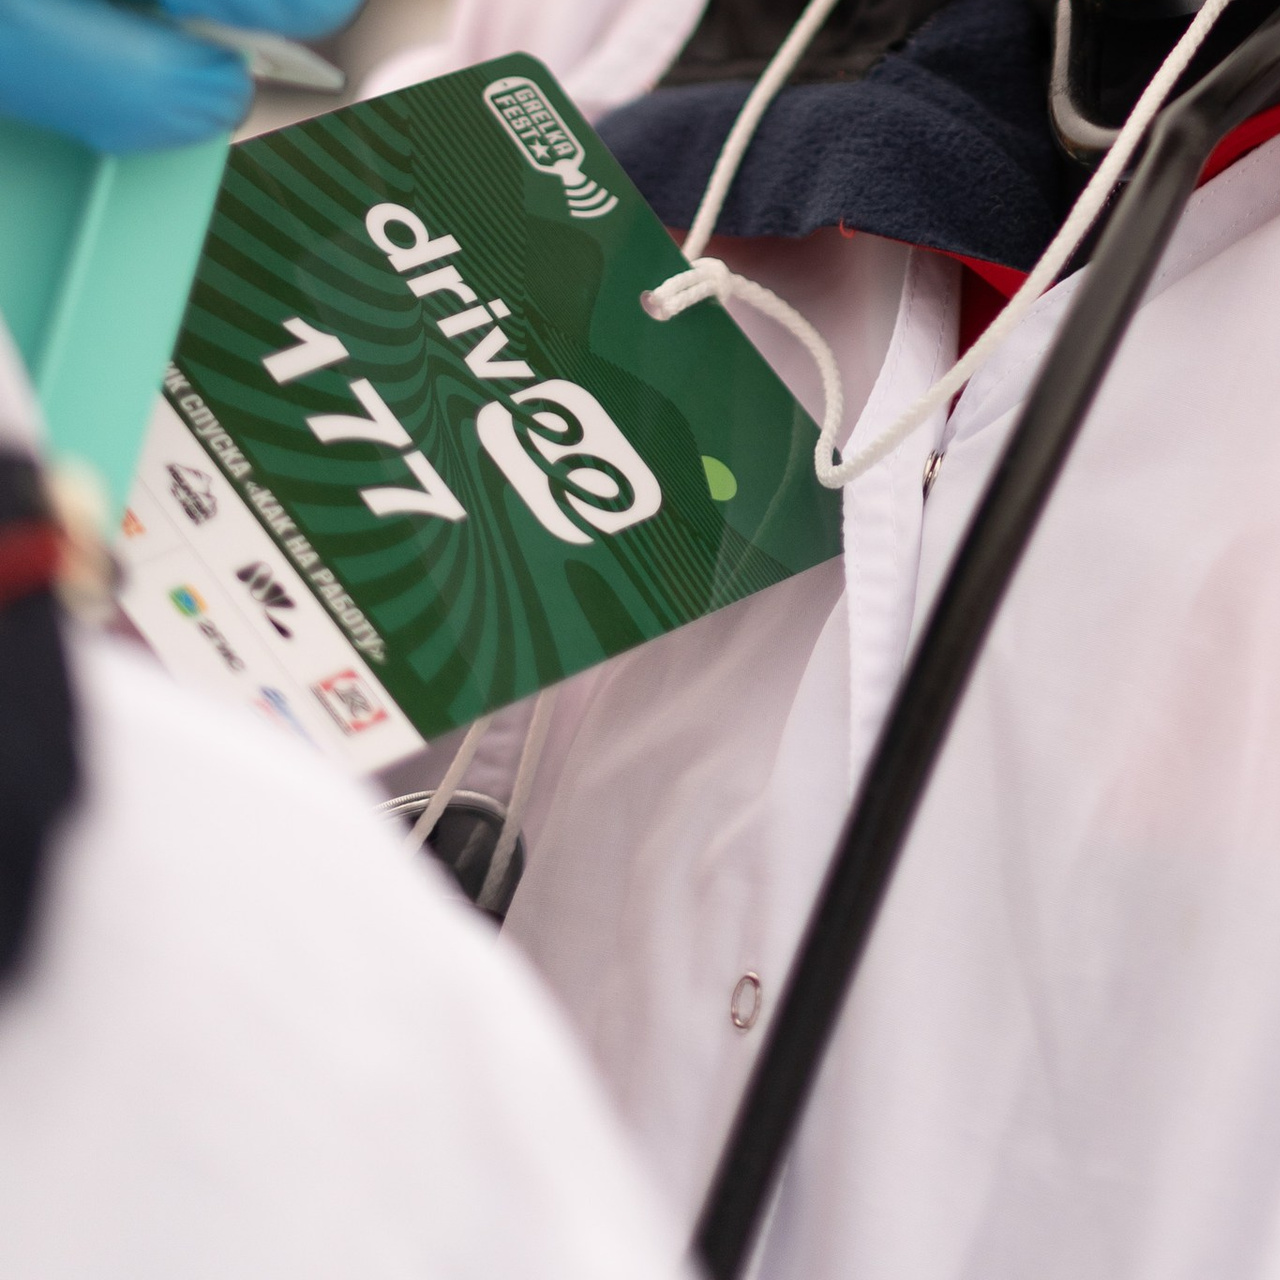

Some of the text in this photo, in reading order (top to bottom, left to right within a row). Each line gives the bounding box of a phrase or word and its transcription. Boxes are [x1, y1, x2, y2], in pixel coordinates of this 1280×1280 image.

[494, 95, 541, 140] FEST
[514, 87, 576, 157] GRELKA
[262, 317, 468, 522] 177
[366, 203, 662, 544] drivee
[179, 393, 252, 481] СПУСКА
[285, 534, 321, 571] НА
